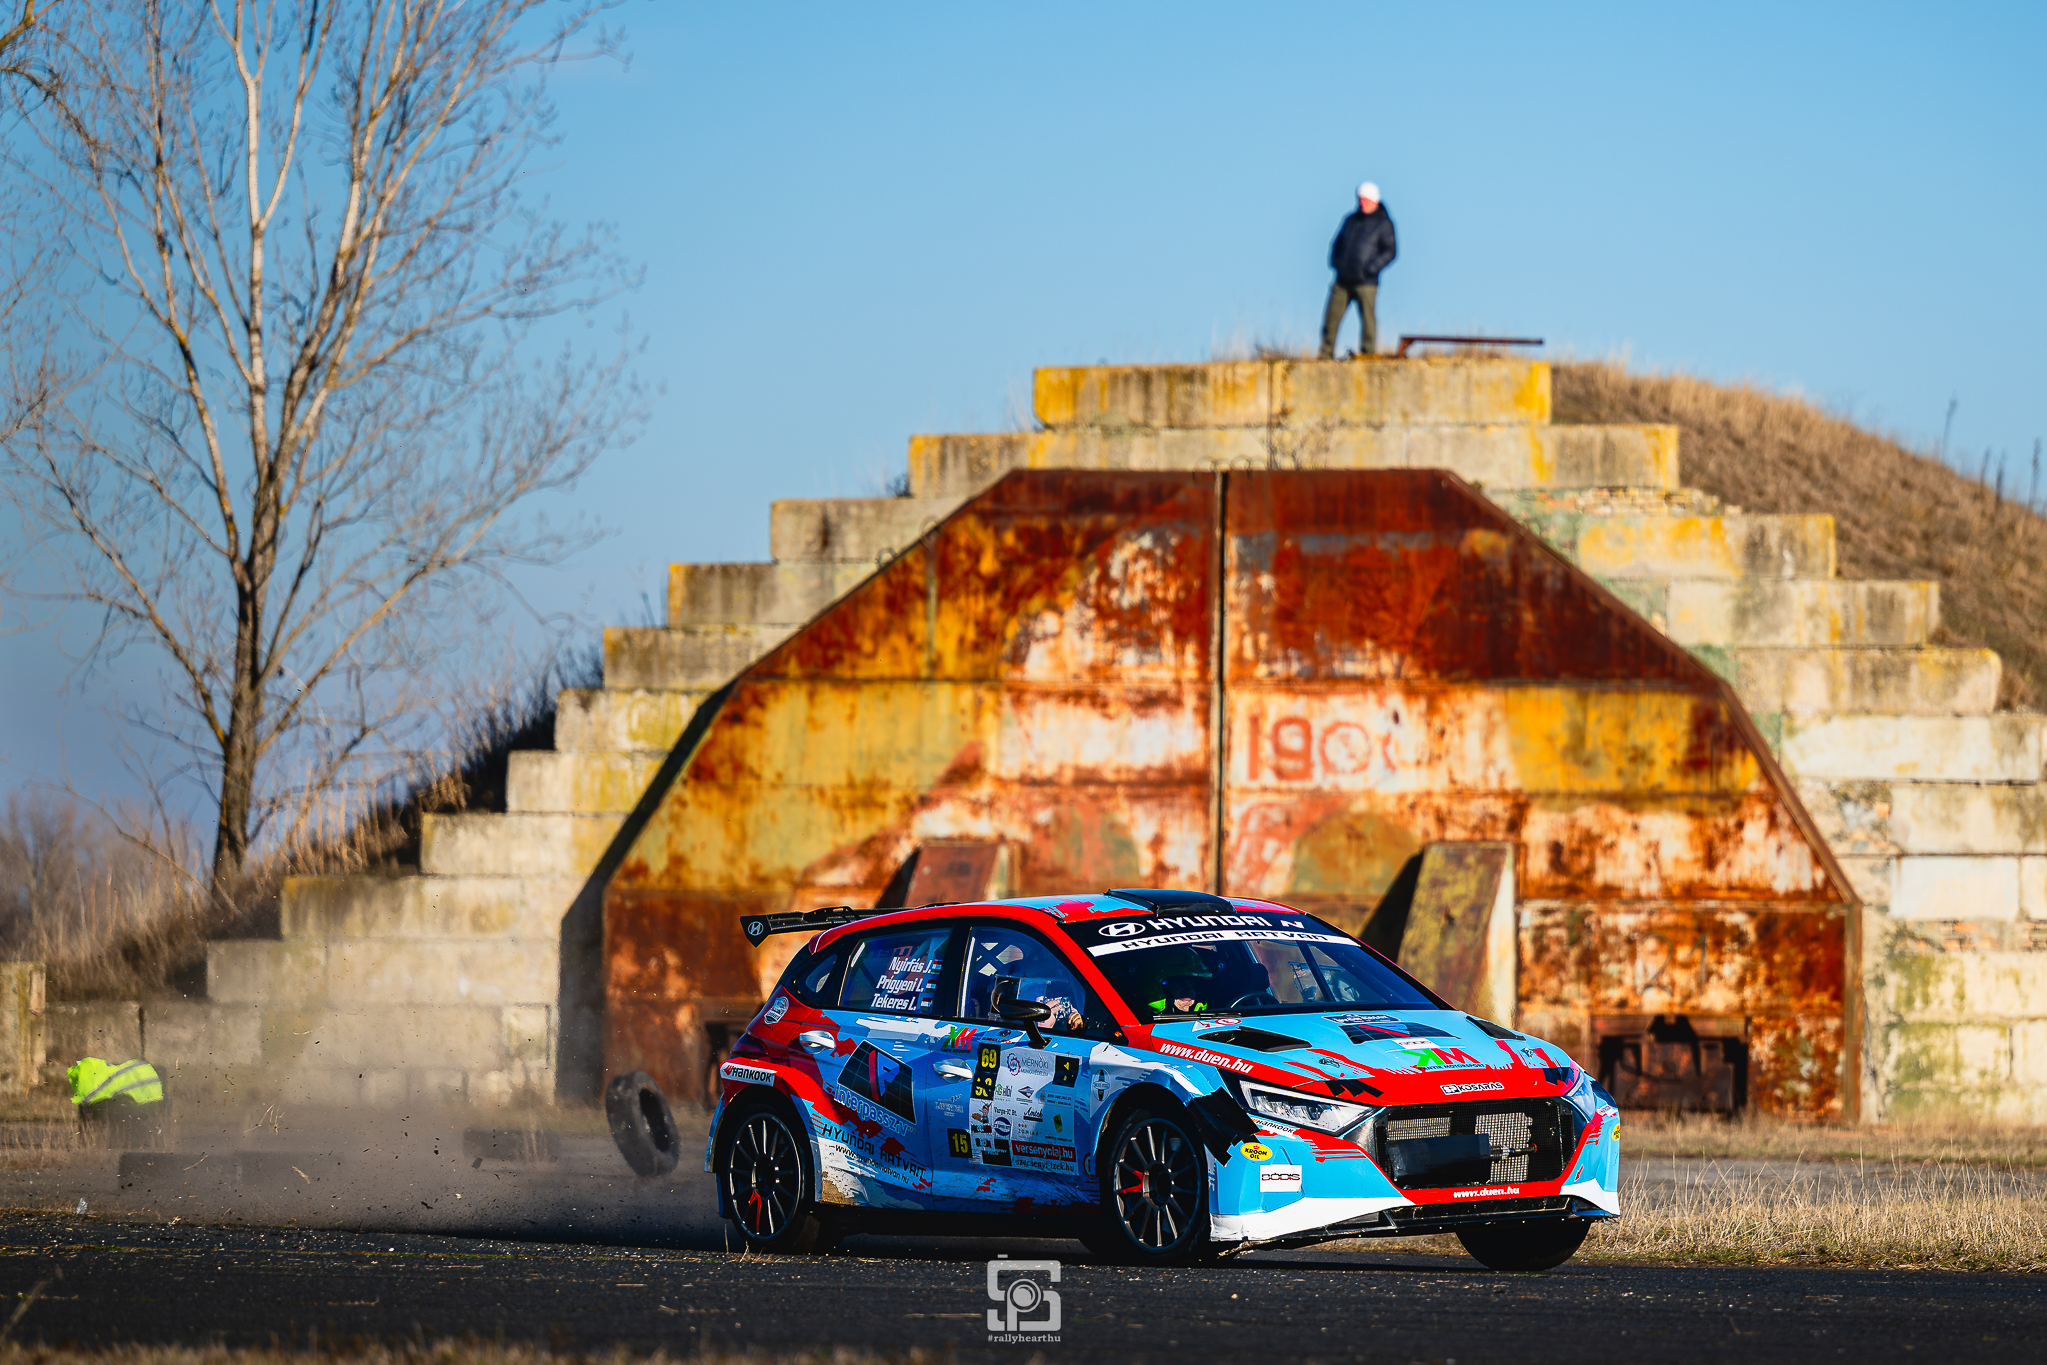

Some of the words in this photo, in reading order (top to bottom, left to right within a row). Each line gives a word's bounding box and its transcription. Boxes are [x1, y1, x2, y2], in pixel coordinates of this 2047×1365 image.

[1146, 915, 1272, 930] HYUNDAI
[1121, 932, 1224, 949] HYUNDAI
[1236, 931, 1329, 941] HATVAN
[870, 993, 909, 1010] Tekeres
[981, 1047, 998, 1069] 69
[1159, 1042, 1254, 1074] www.duen.hu
[1457, 1082, 1504, 1093] KOSARAS
[822, 1123, 875, 1156] HYUNDAI
[879, 1150, 925, 1179] HATVAN
[952, 1132, 968, 1154] 15
[1244, 1147, 1268, 1156] KROON
[1015, 1144, 1073, 1160] versenyolaj.hu
[1453, 1186, 1520, 1198] www.duen.hu
